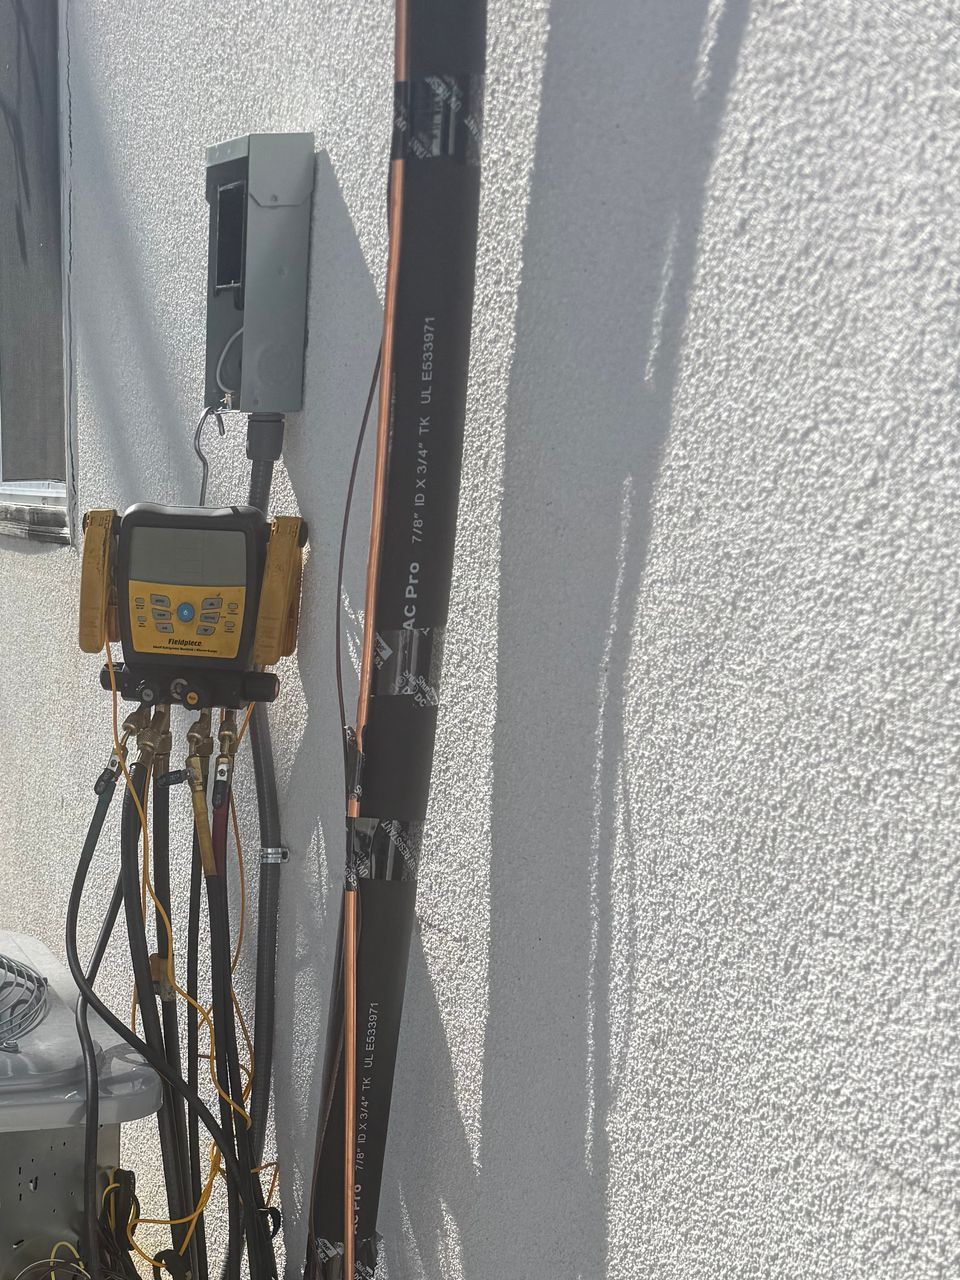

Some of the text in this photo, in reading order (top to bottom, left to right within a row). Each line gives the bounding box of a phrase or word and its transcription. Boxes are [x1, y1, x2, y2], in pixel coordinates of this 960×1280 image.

[422, 317, 435, 381] E533971
[421, 386, 432, 404] UL
[418, 416, 430, 435] TK
[416, 479, 426, 488] X
[414, 493, 425, 506] ID
[405, 562, 420, 598] Pro
[403, 604, 417, 631] AC
[365, 1002, 379, 1051] E533971
[364, 1054, 374, 1068] UL
[362, 1077, 371, 1091] TK
[357, 1133, 366, 1143] ID
